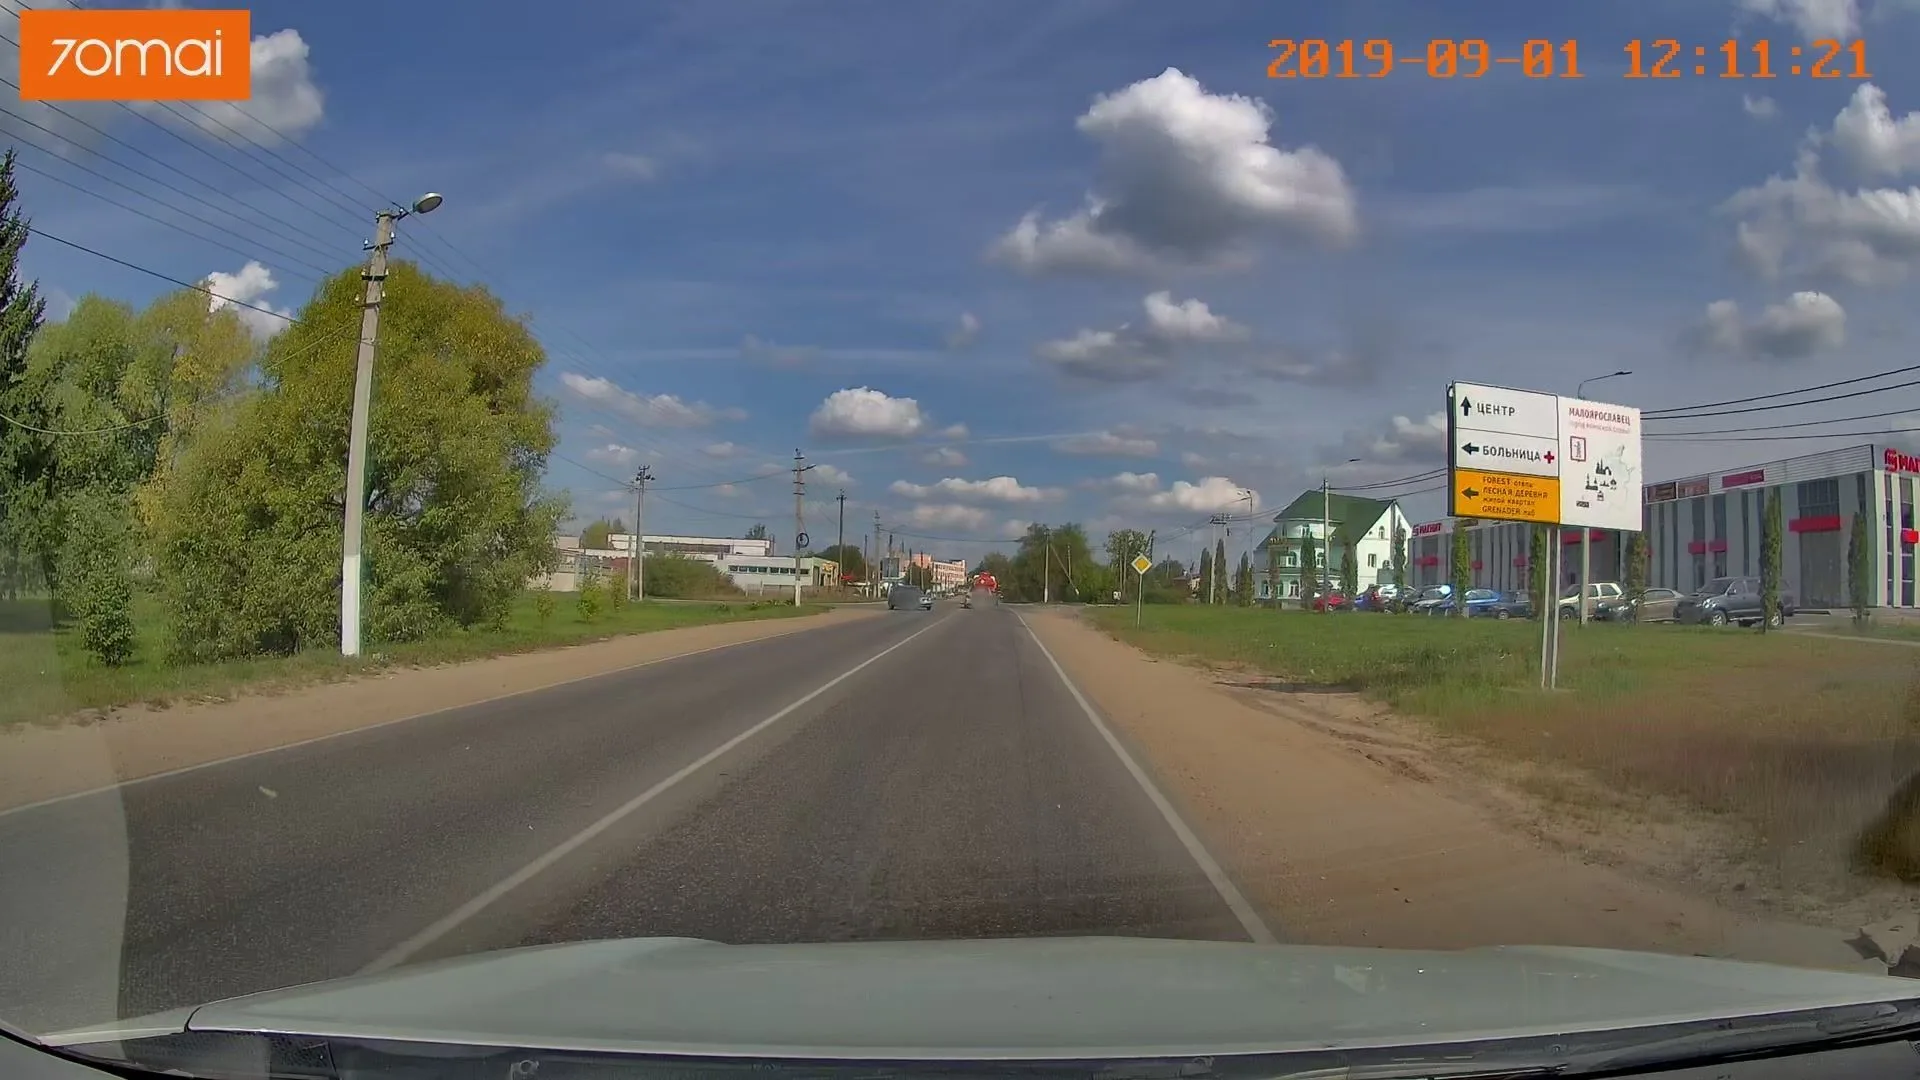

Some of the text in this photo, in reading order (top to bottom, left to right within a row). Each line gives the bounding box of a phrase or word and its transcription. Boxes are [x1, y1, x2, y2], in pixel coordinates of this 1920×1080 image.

[1477, 402, 1515, 416] ЦЕНТР
[1569, 407, 1631, 426] МАЛОЯРОСЛАВЕЦ
[1483, 445, 1541, 462] БОЛЬНИЦА
[1483, 476, 1510, 485] FOREST
[1482, 486, 1548, 499] ЛЕСНАЯ ДЕРЕВНЯ
[1482, 505, 1521, 516] GRENADER
